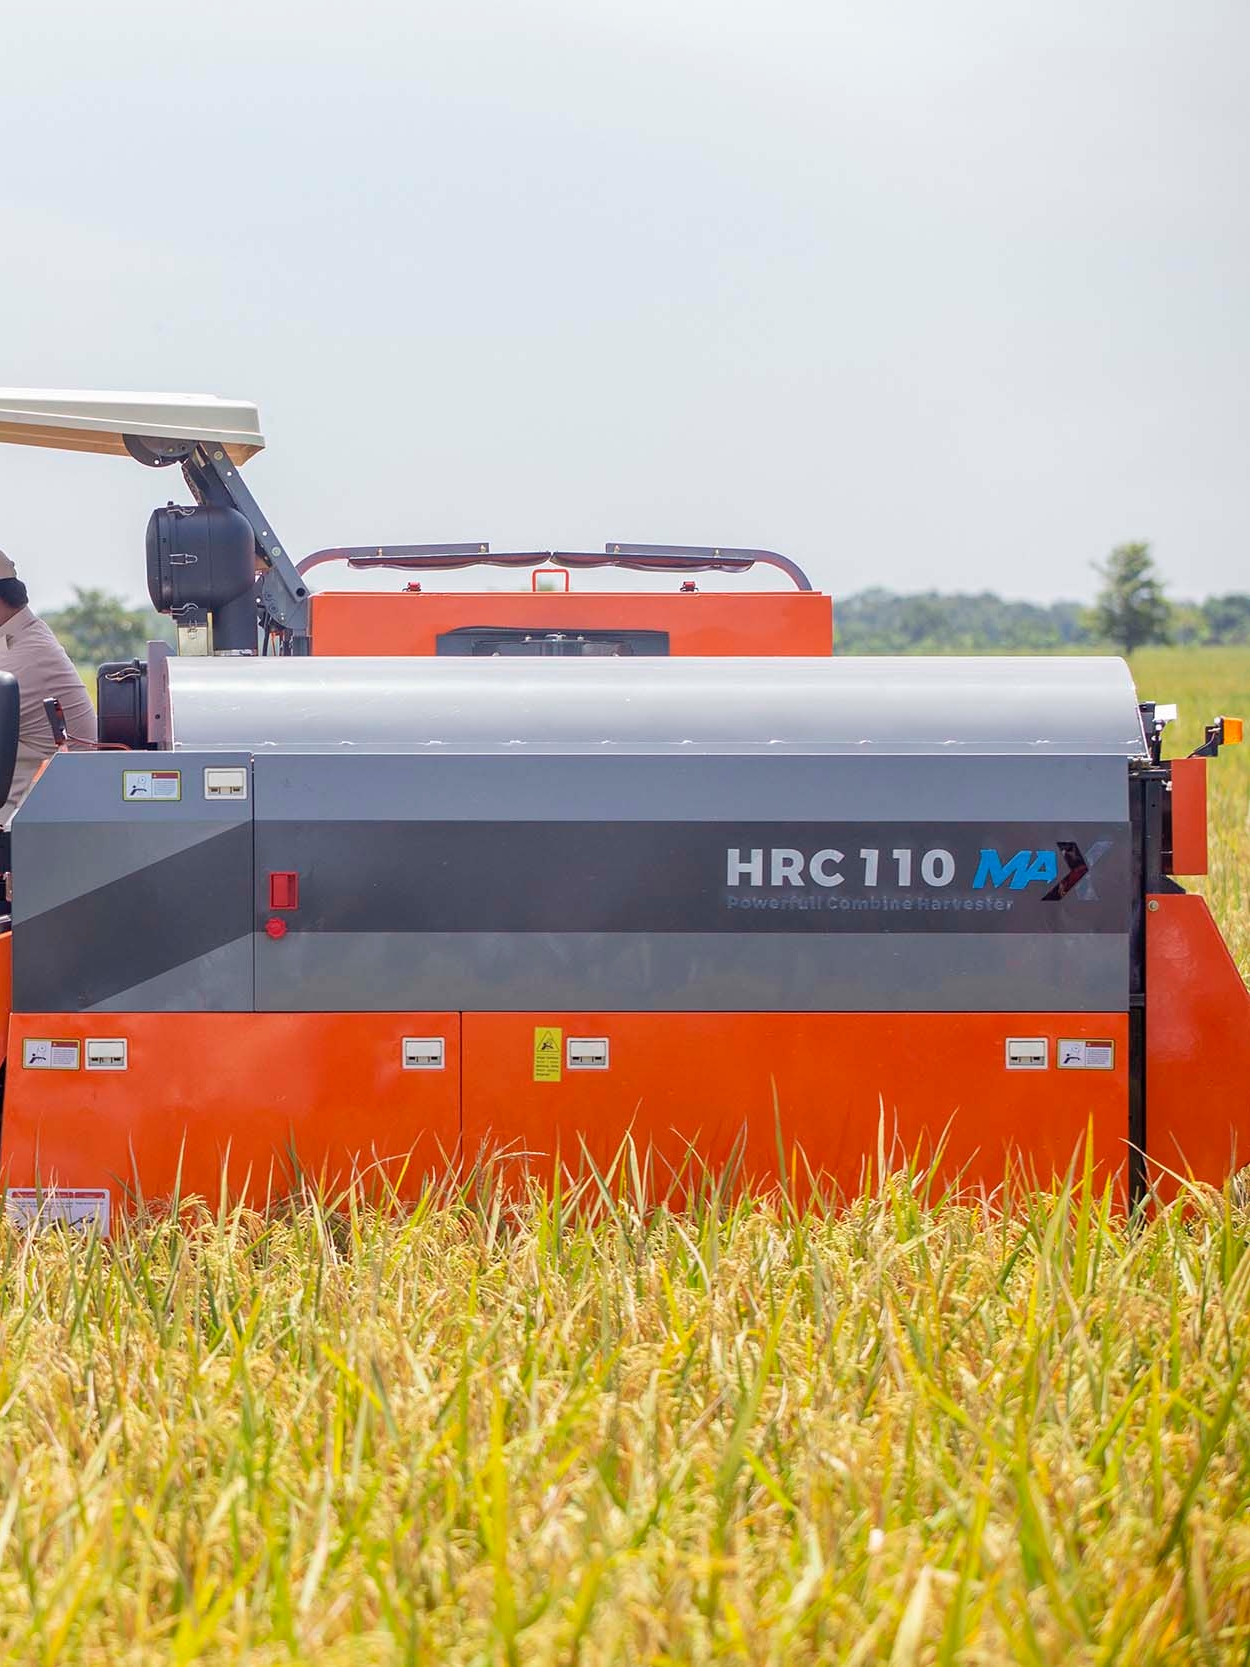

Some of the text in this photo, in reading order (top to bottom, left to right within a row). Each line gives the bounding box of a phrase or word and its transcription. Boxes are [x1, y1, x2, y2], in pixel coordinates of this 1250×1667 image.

[726, 841, 1114, 901] HRC 110 MAX
[726, 895, 1014, 912] Powerfull Combine Harvester
